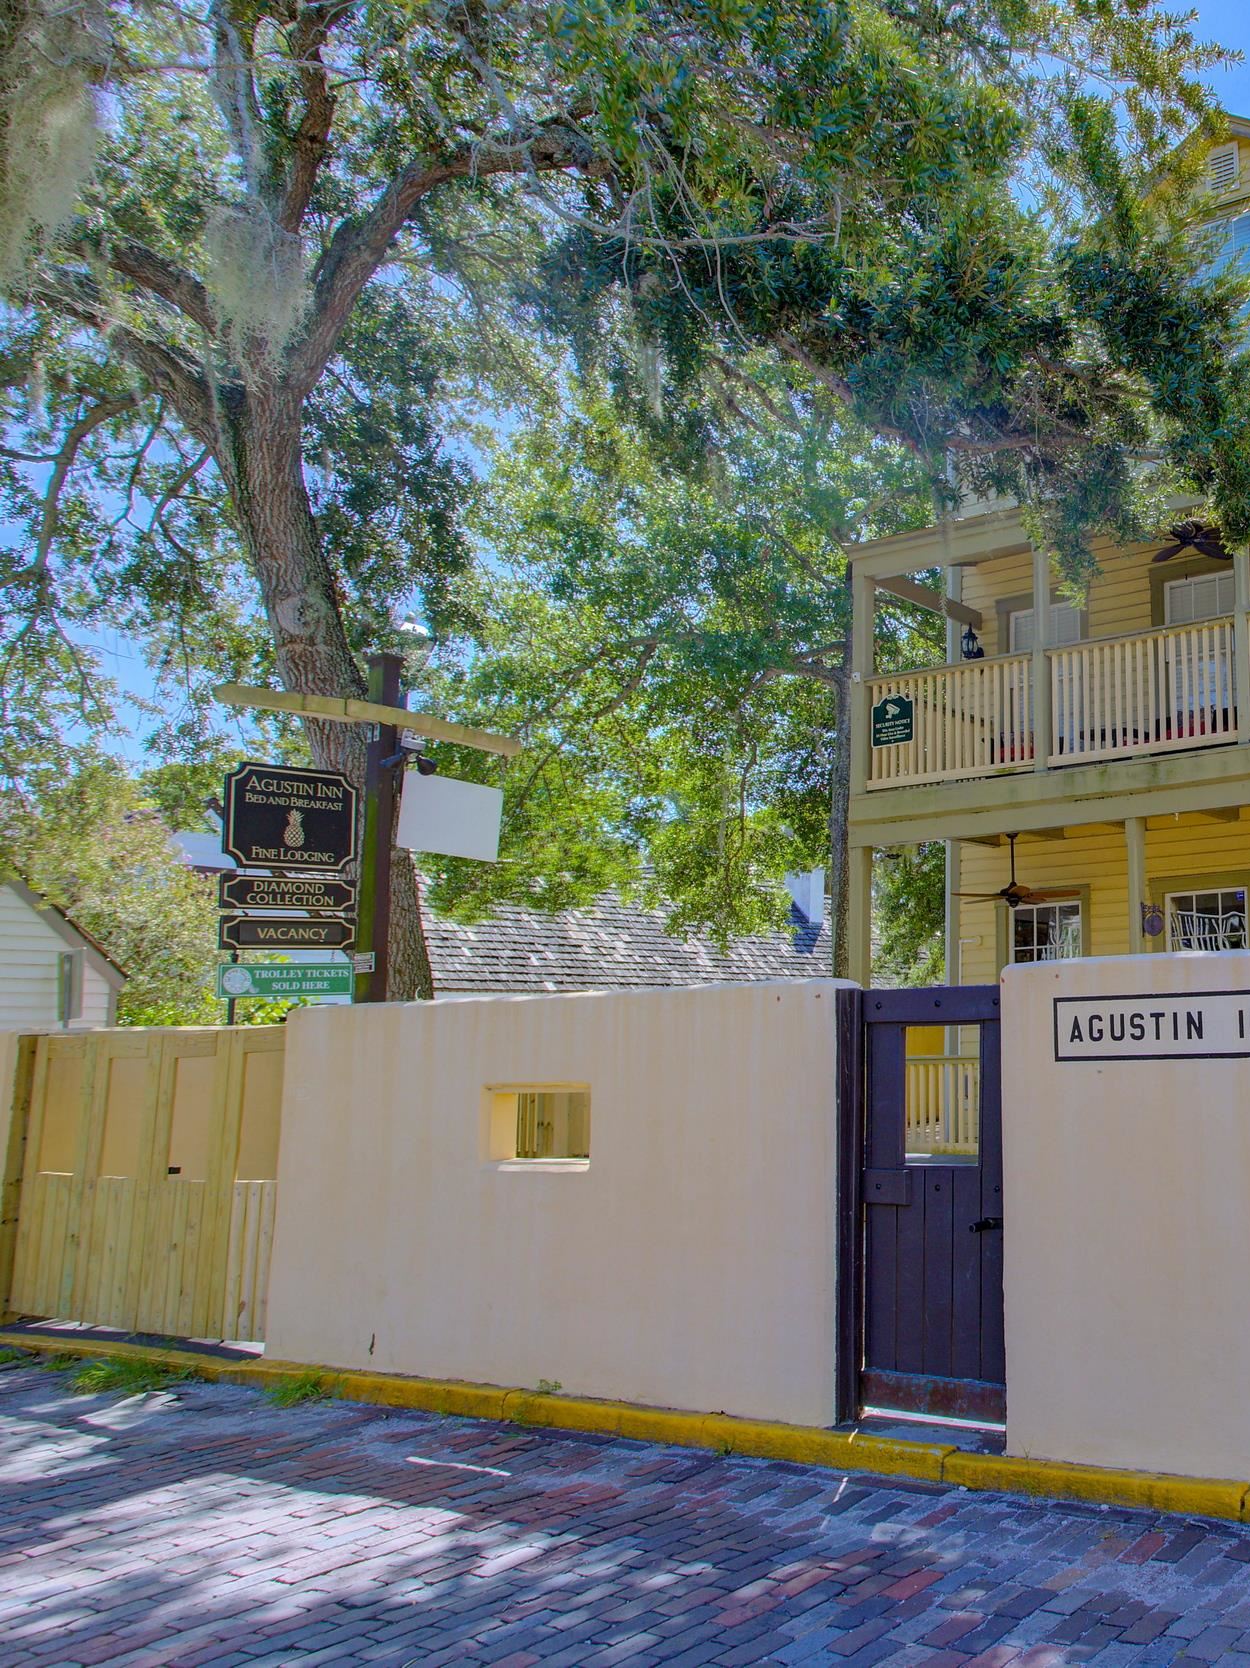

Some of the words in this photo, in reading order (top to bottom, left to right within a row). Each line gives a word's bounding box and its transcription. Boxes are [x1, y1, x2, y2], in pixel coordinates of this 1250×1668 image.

[246, 775, 314, 796] AGUSTIN
[316, 783, 344, 799] INN
[245, 792, 266, 803] BED
[267, 796, 290, 806] AND
[290, 797, 344, 811] BREAKFAST
[251, 846, 279, 859] FINE
[279, 848, 335, 863] LODGING
[253, 881, 325, 894] DIAMOND
[246, 893, 334, 906] COLLECTION
[257, 927, 328, 939] VACANCY
[254, 969, 304, 979] TROLLEY
[306, 969, 350, 978] TICKETS
[271, 981, 300, 991] SOLD
[302, 981, 330, 990] HERE
[1069, 1010, 1204, 1043] AGUSTIN
